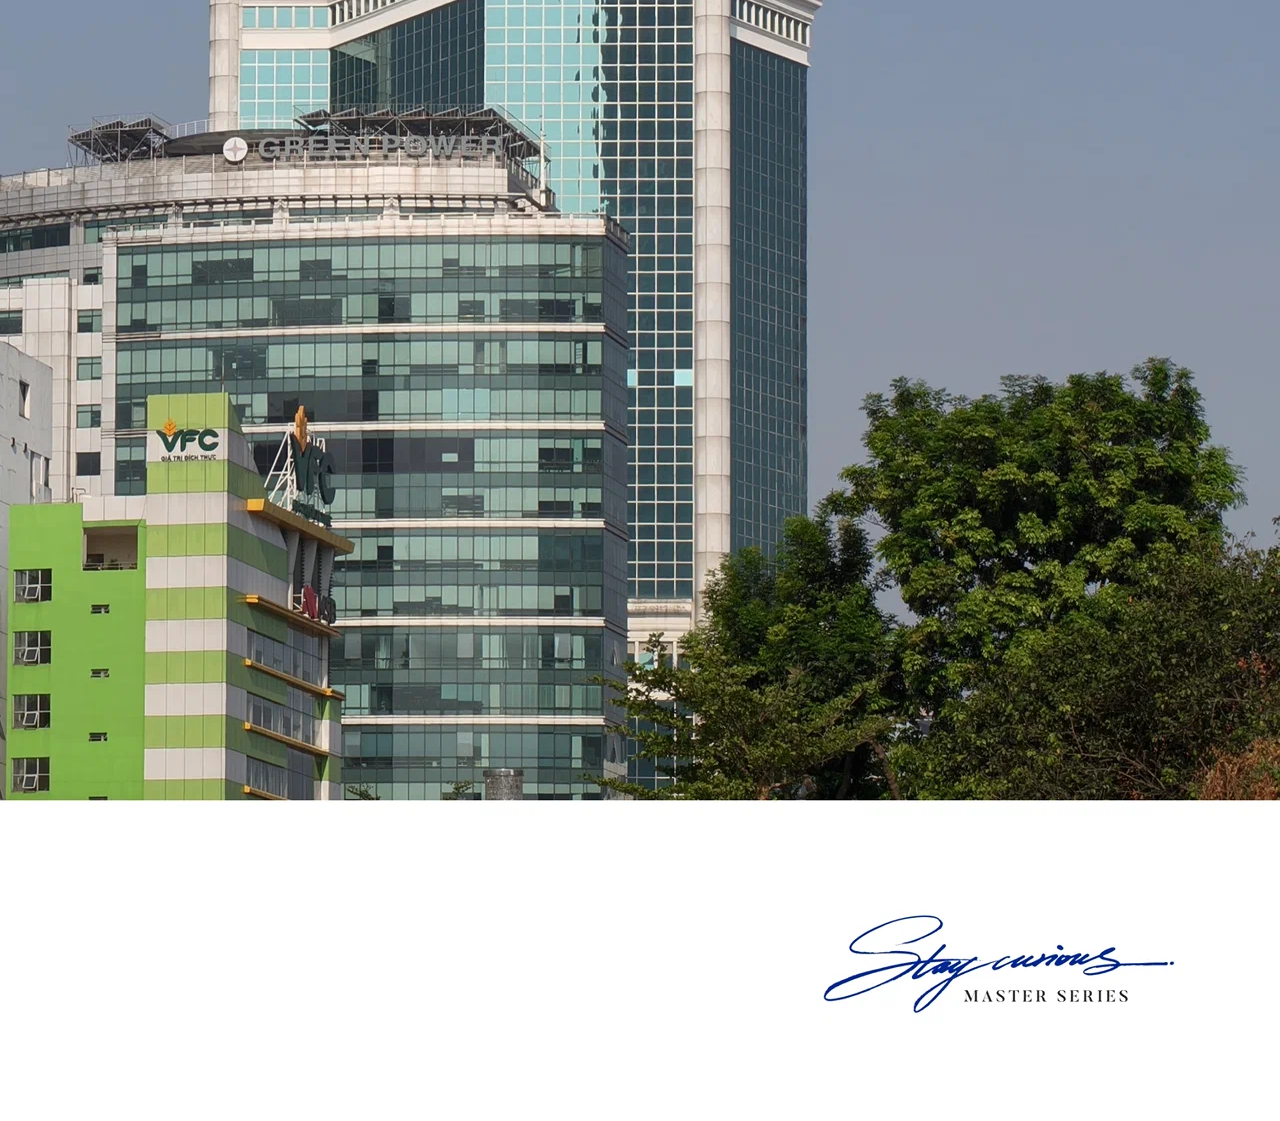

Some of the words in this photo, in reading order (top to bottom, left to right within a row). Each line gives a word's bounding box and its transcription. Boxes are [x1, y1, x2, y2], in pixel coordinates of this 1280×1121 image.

[258, 135, 370, 159] GREEN
[381, 134, 503, 159] POWER
[156, 429, 219, 453] VFC
